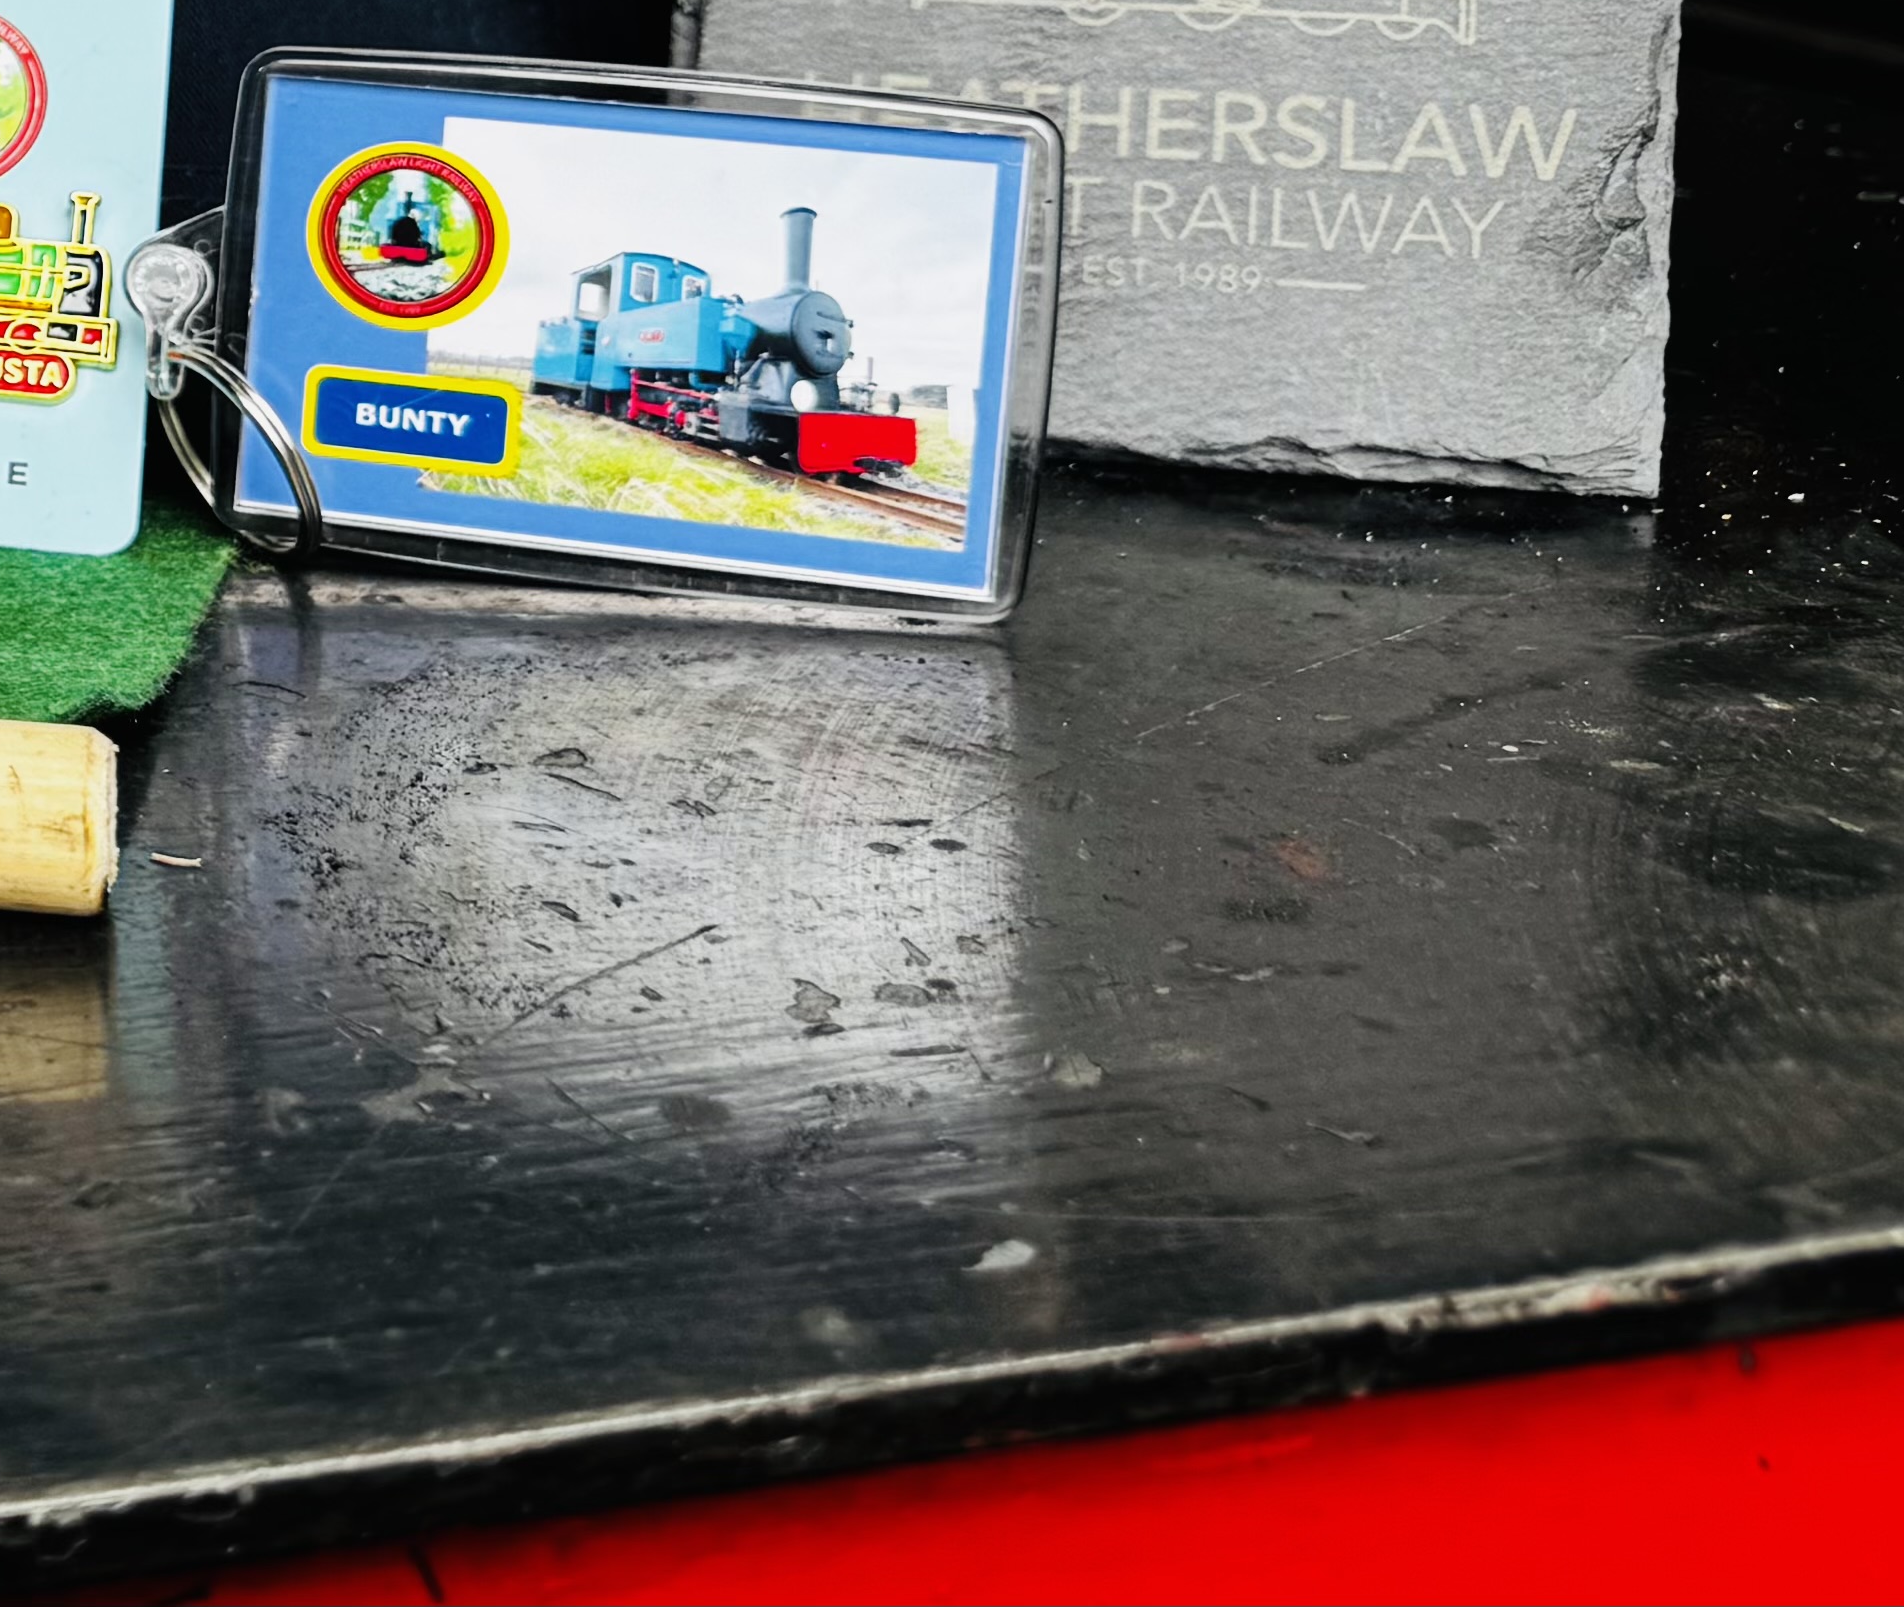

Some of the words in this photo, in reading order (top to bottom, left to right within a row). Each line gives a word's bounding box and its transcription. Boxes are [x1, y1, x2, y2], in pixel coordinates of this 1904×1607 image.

[408, 156, 441, 173] LIGHT
[1130, 180, 1508, 262] RAILWAY
[1173, 261, 1264, 295] 1989
[353, 400, 473, 440] BUNTY
